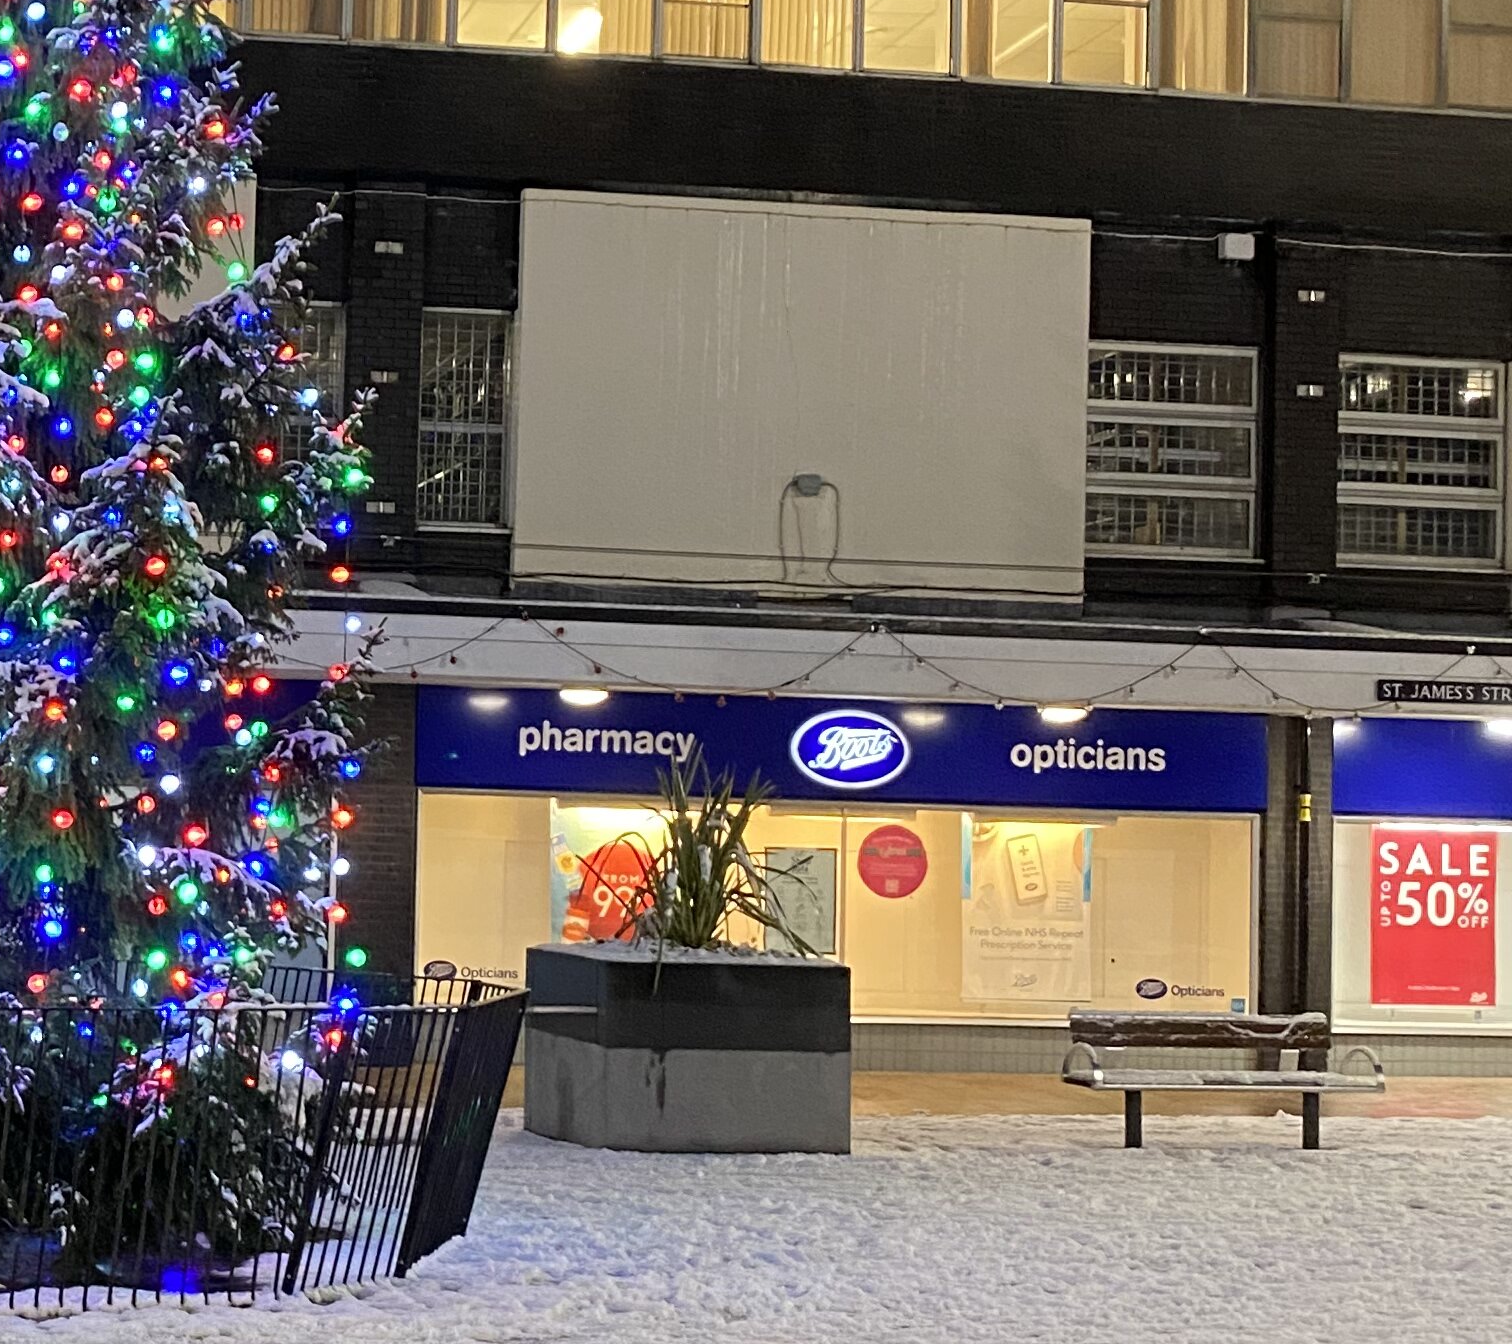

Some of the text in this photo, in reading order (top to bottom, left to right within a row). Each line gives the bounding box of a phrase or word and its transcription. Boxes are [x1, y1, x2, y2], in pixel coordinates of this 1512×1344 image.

[518, 719, 696, 763] pharmacy
[807, 725, 899, 772] Boots
[1009, 737, 1167, 774] opticians
[1379, 841, 1490, 877] SALE
[603, 874, 640, 885] FROM
[1379, 880, 1392, 927] UP TO
[1395, 881, 1489, 927] 50%
[969, 925, 990, 937] Free
[1025, 927, 1047, 938] NHS
[1456, 915, 1489, 929] OFF
[980, 938, 1073, 952] Prescription Service
[460, 966, 519, 980] Opticians
[1170, 984, 1225, 998] Opticians
